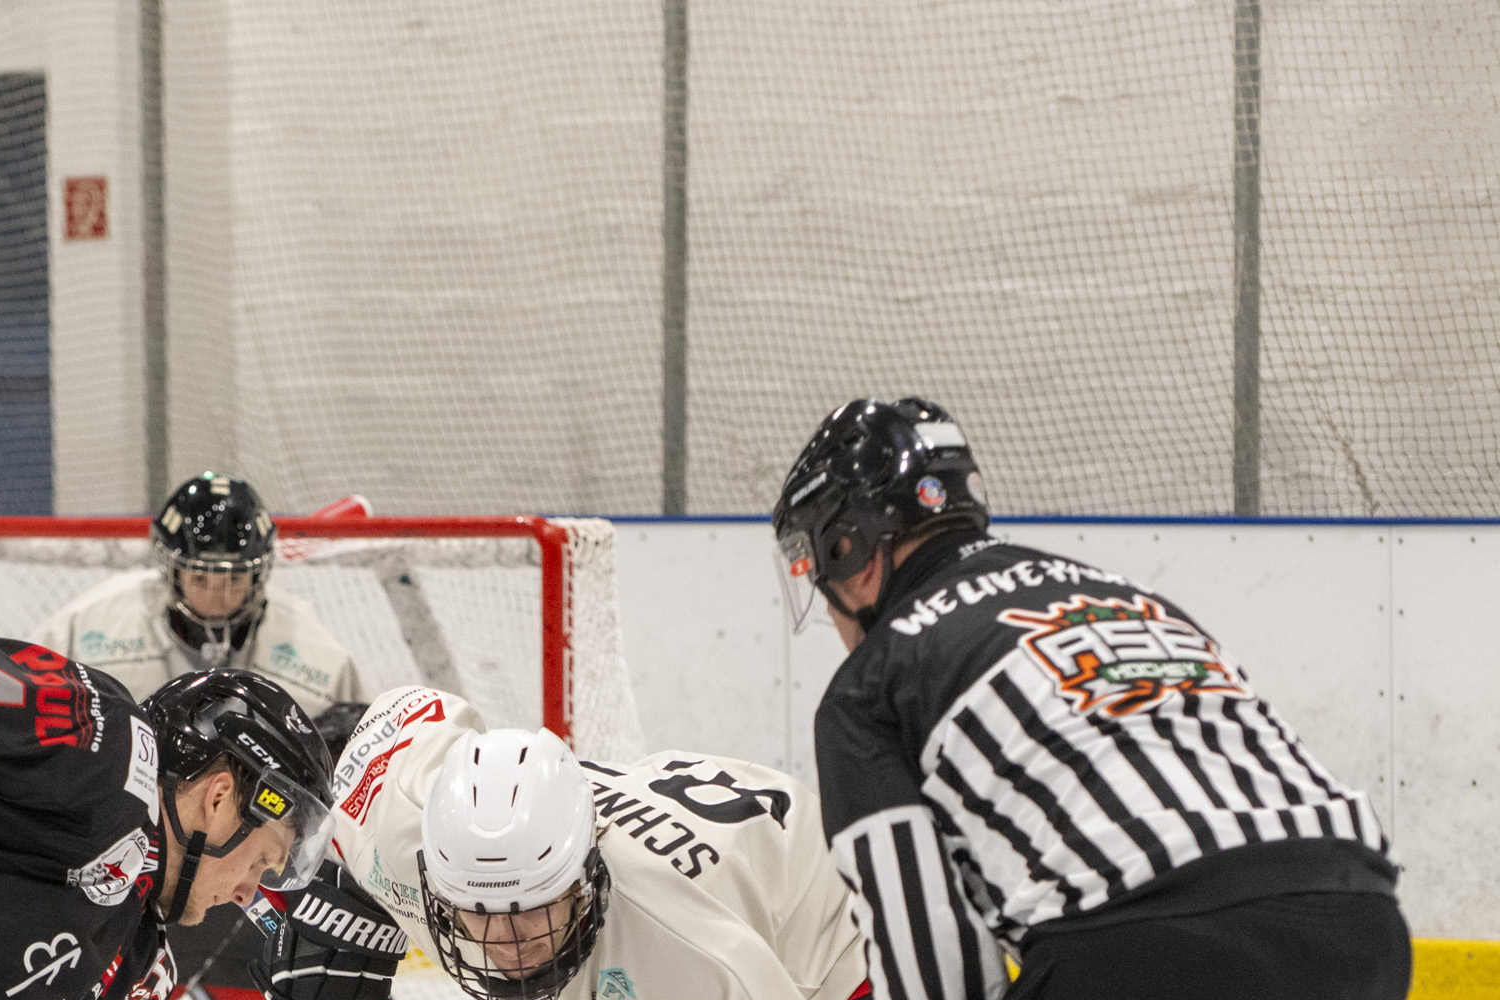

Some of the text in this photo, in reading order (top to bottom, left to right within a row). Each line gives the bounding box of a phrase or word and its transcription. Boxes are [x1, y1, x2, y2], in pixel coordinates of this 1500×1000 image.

[890, 589, 957, 635] WE
[957, 560, 1045, 604] LIVE
[1107, 660, 1200, 681] HOCKEY
[238, 733, 280, 769] CCM
[466, 879, 520, 888] WARRIOR
